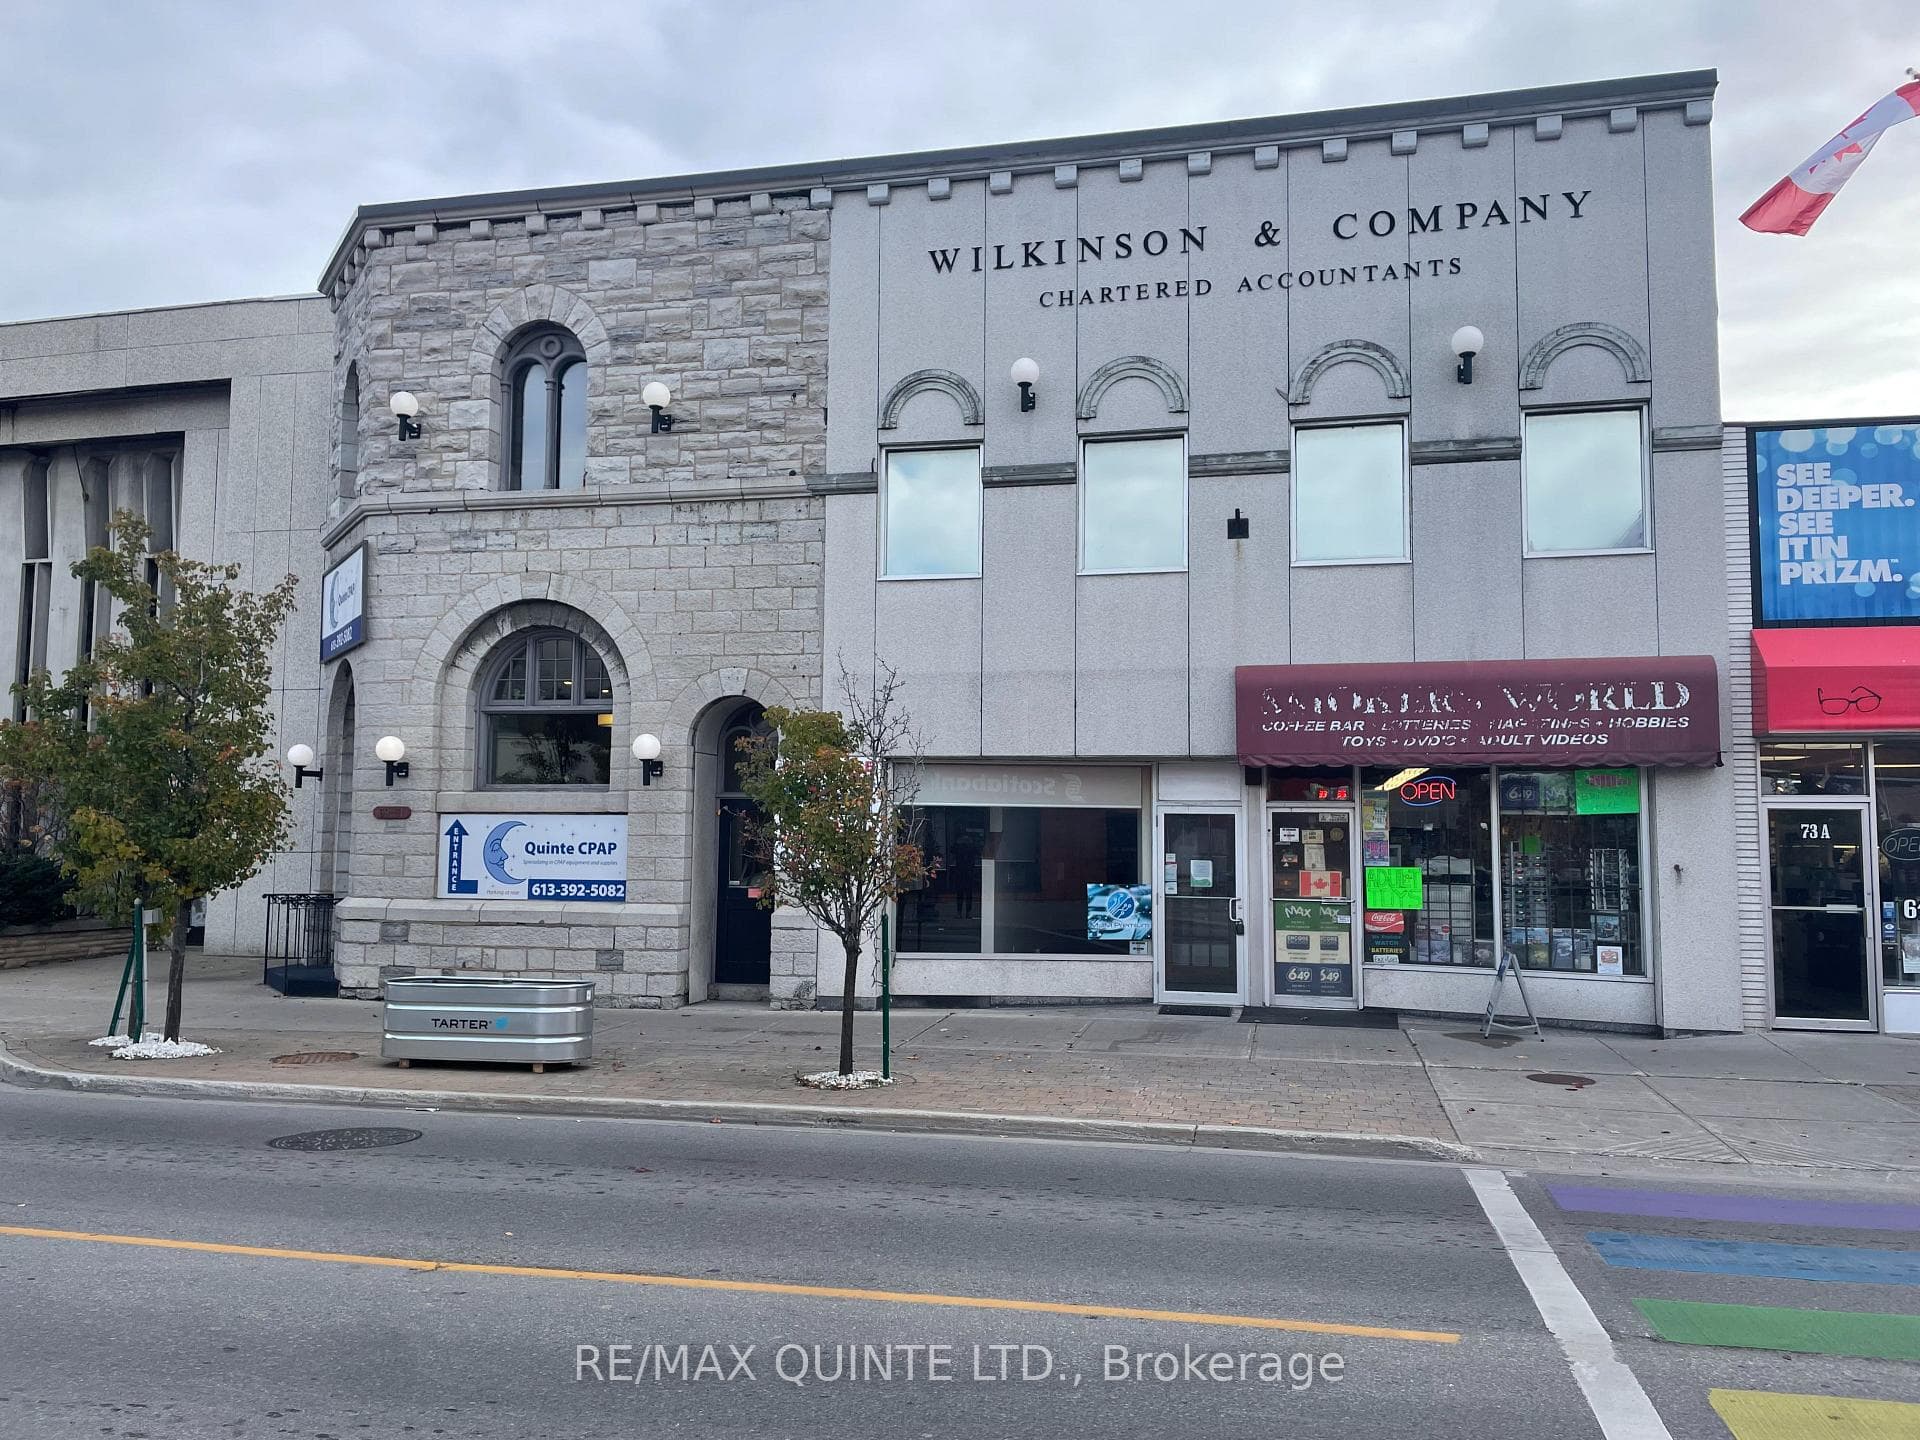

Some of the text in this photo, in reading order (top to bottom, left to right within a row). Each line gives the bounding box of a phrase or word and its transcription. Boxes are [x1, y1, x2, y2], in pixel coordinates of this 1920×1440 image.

[928, 189, 1593, 275] WILKINSON & COMPANY
[1038, 256, 1463, 310] CHARTERED ACCOUNTANTS
[1776, 462, 1832, 487] SEE
[1777, 483, 1916, 512] DEEPER.
[1778, 512, 1834, 536] SEE
[1779, 535, 1848, 561] IT IN
[1330, 719, 1366, 731] BAR
[1489, 717, 1590, 730] MAGZINES
[1608, 716, 1690, 729] HOBBIES
[1342, 736, 1387, 747] TOYS
[1540, 733, 1609, 746] VIDEOS
[1400, 781, 1456, 801] OPEN
[524, 841, 618, 856] Quinte CPAP
[1884, 836, 1920, 853] OPE
[451, 827, 459, 892] ENTRANCE
[532, 883, 625, 898] 613-392-5082
[1284, 905, 1312, 918] MAX
[1903, 899, 1920, 920] 6
